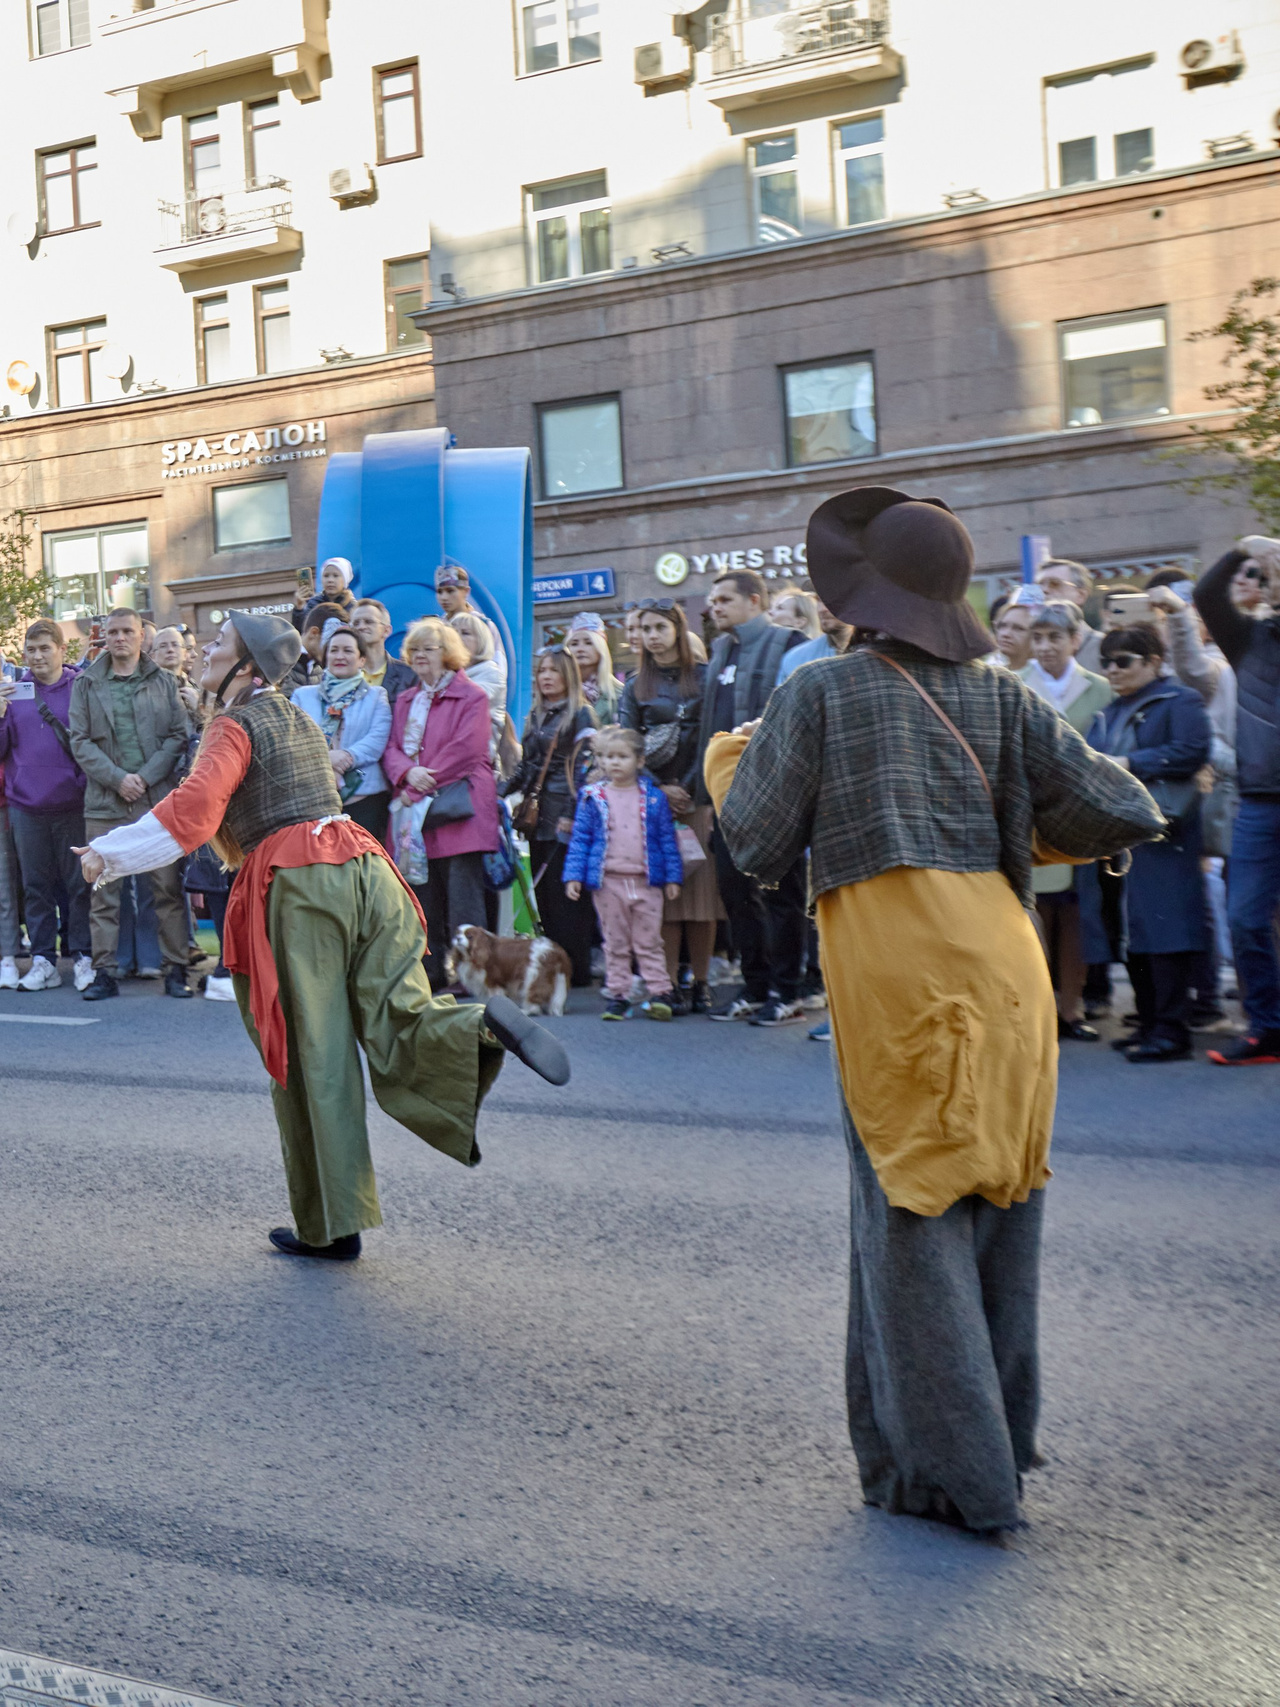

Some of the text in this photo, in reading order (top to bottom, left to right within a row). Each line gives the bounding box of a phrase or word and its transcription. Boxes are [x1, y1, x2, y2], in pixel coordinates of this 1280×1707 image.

[161, 421, 326, 465] SPA-САЛОН
[161, 448, 327, 479] РАСТИТЕЛЬНОЙ КОСМЕТИКИ
[691, 548, 764, 574] YVES
[532, 574, 606, 592] ВЕРСКАЯ 4
[251, 603, 295, 616] ROCHER
